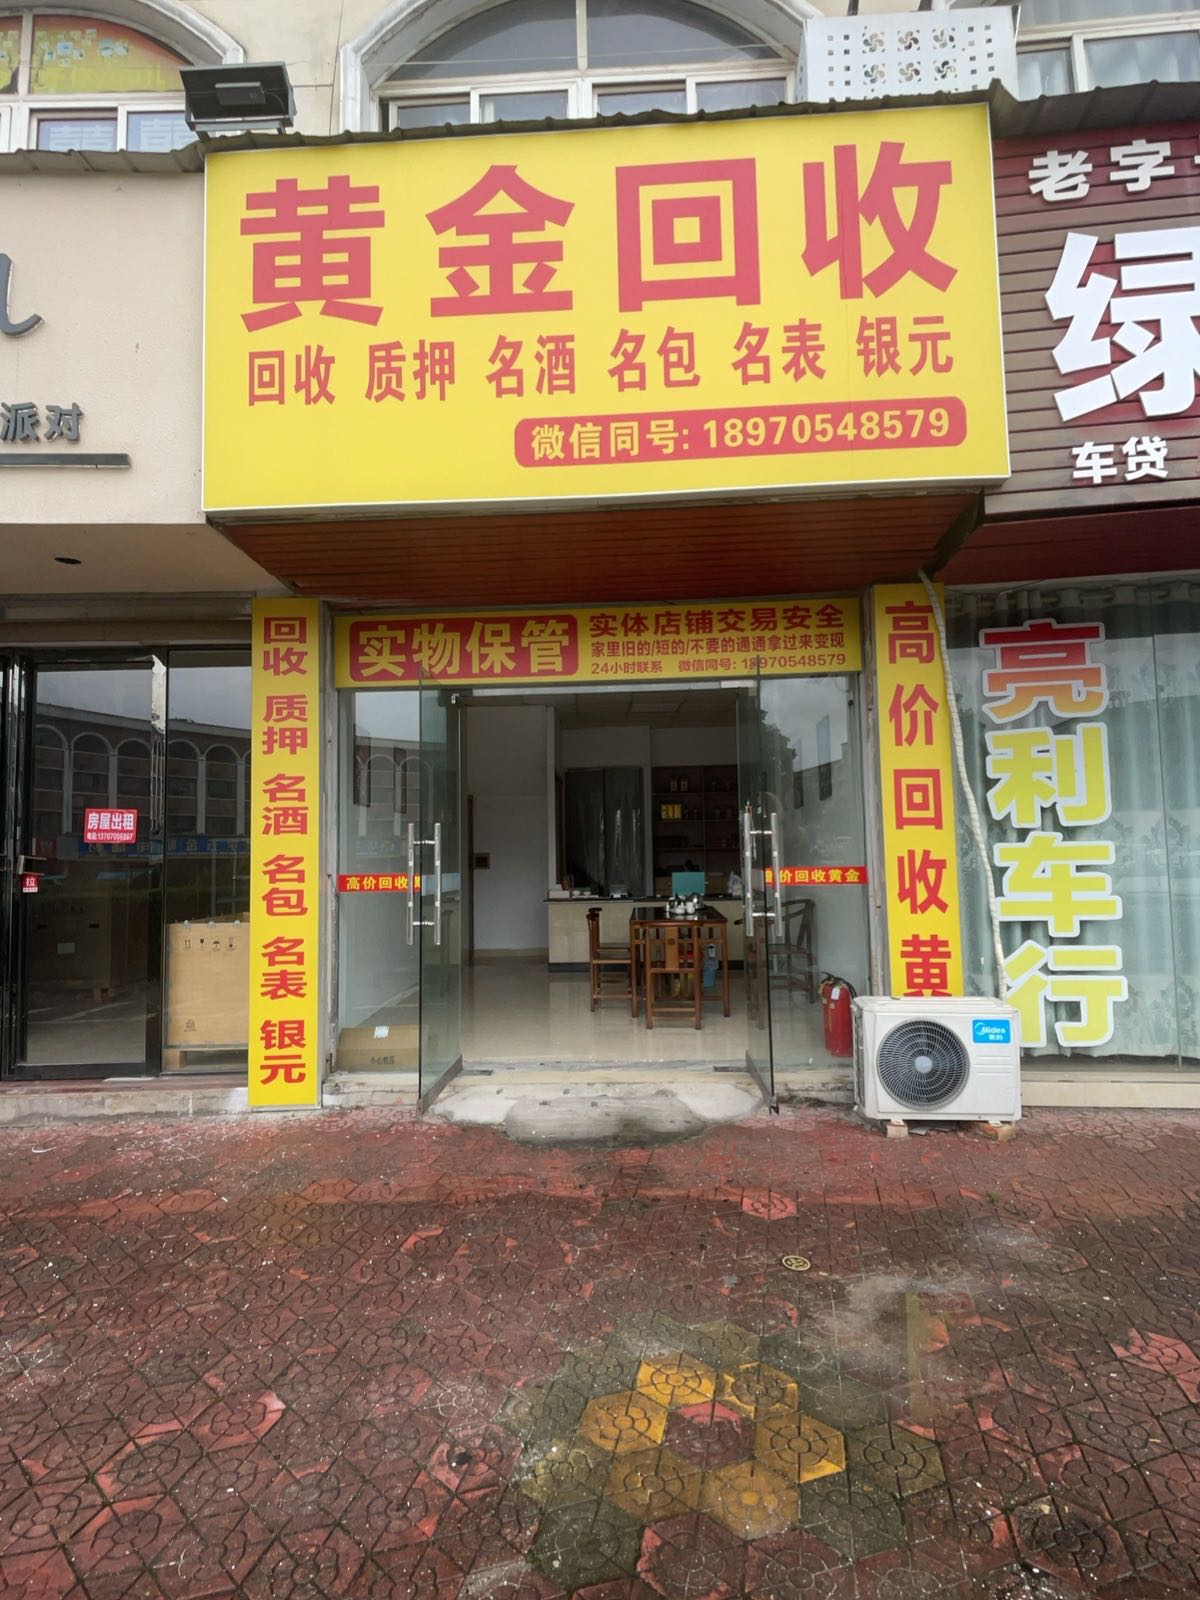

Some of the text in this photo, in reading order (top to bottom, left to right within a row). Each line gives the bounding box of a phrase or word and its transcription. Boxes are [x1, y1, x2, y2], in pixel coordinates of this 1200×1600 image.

[1028, 139, 1200, 202] 老字
[240, 141, 958, 332] 黄金回收
[248, 315, 953, 407] 回收 质押 名酒 名包 名表 银元
[0, 402, 84, 443] 派对
[703, 407, 950, 449] 18970548579
[1071, 436, 1169, 485] 车贷
[589, 604, 845, 638] 实体店铺交易安全
[358, 619, 570, 677] 实物保管
[591, 660, 663, 675] 24小时联系
[88, 811, 134, 830] 房屋出租
[885, 601, 953, 997] 高价回收黄
[260, 617, 309, 1084] 回收 质押 名酒 名包 名表 银元
[982, 619, 1127, 1048] 亮利车行
[346, 875, 420, 890] 高价回收
